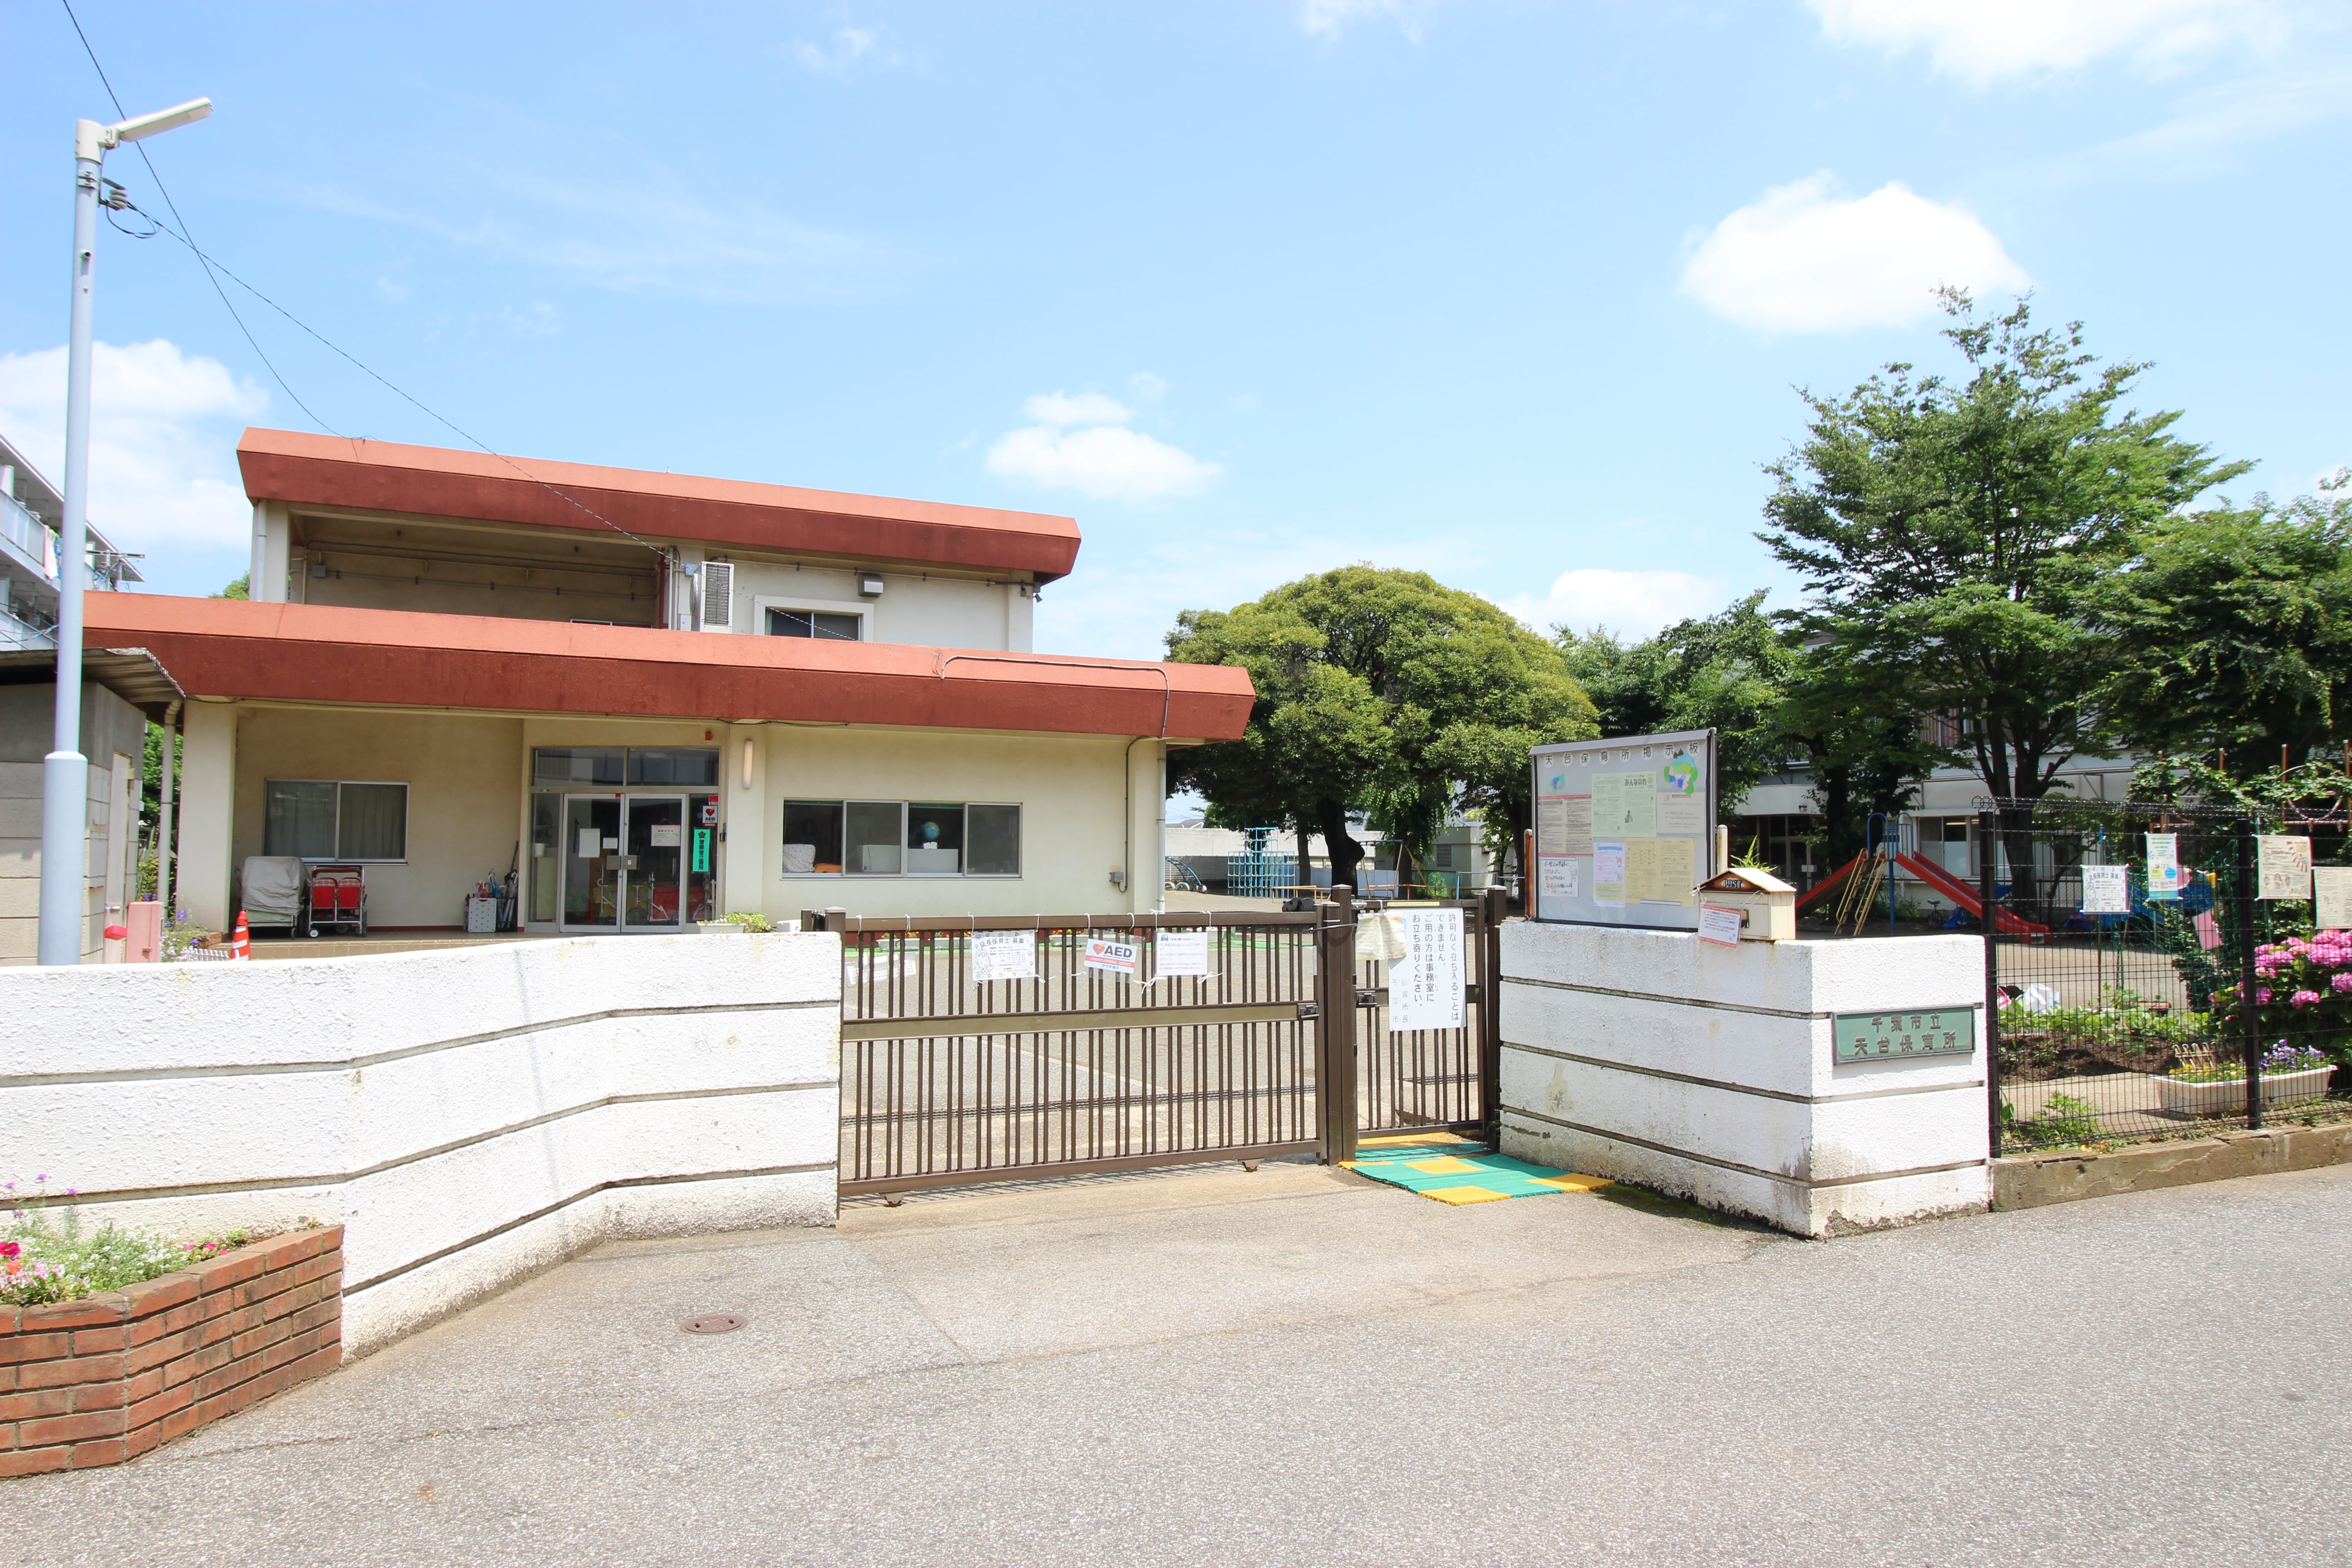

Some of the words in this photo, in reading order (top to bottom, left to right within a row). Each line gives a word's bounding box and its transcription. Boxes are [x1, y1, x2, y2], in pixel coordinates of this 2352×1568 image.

[1545, 743, 1698, 765] 天台保育所掲示板
[1625, 776, 1647, 787] みんなのわ
[1724, 879, 1742, 888] POST
[980, 937, 1010, 948] 延長保育士
[1437, 913, 1446, 966] できません。
[1104, 945, 1132, 958] AED
[1412, 914, 1423, 1007] お立ち寄りください。
[1425, 913, 1435, 1002] ご用の方は事務室に
[1449, 913, 1459, 1021] 許可なく立ち入ることは
[1871, 1012, 1941, 1033] 千葉市立
[1854, 1030, 1957, 1056] 天台保育所
